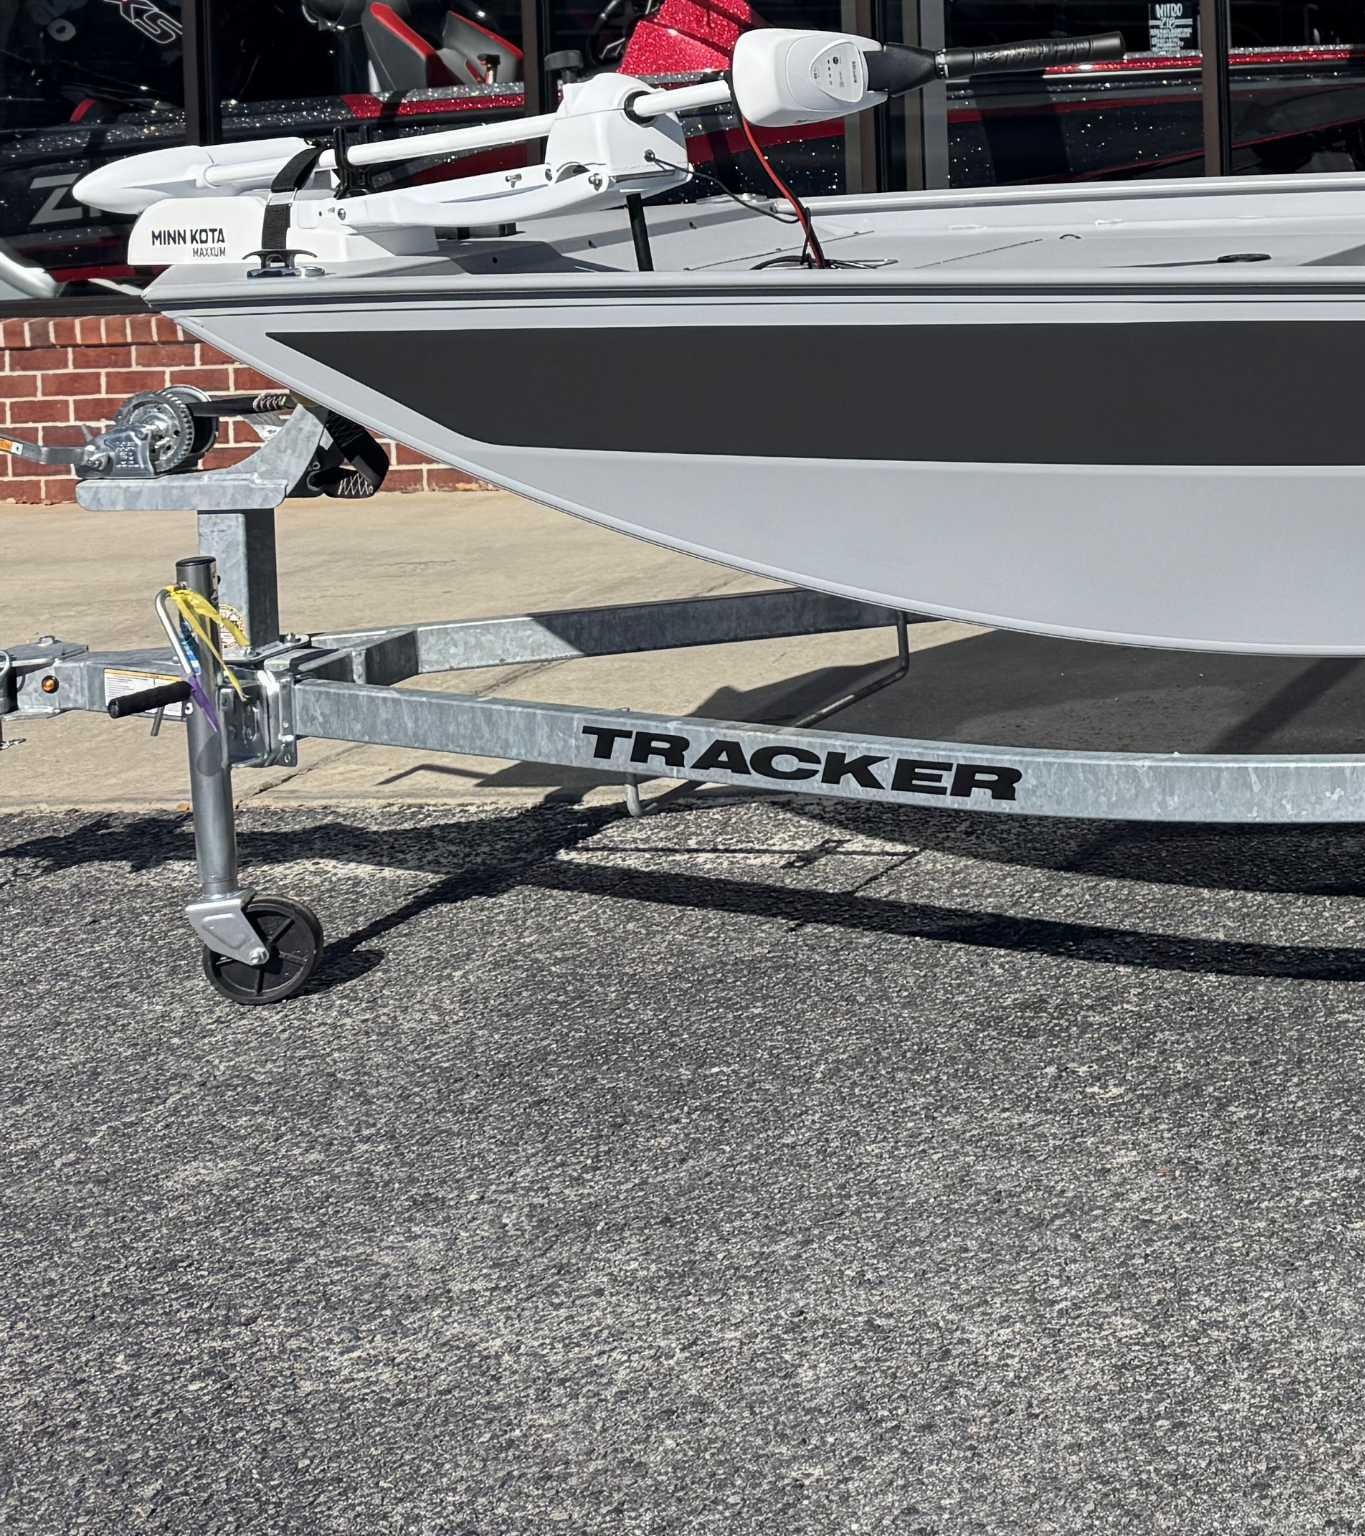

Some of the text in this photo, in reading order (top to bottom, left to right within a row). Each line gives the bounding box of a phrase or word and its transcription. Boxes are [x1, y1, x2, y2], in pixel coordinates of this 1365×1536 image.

[151, 227, 226, 247] MINN KOTA
[192, 246, 226, 258] MAXXUM
[582, 725, 1023, 801] TRACKER
